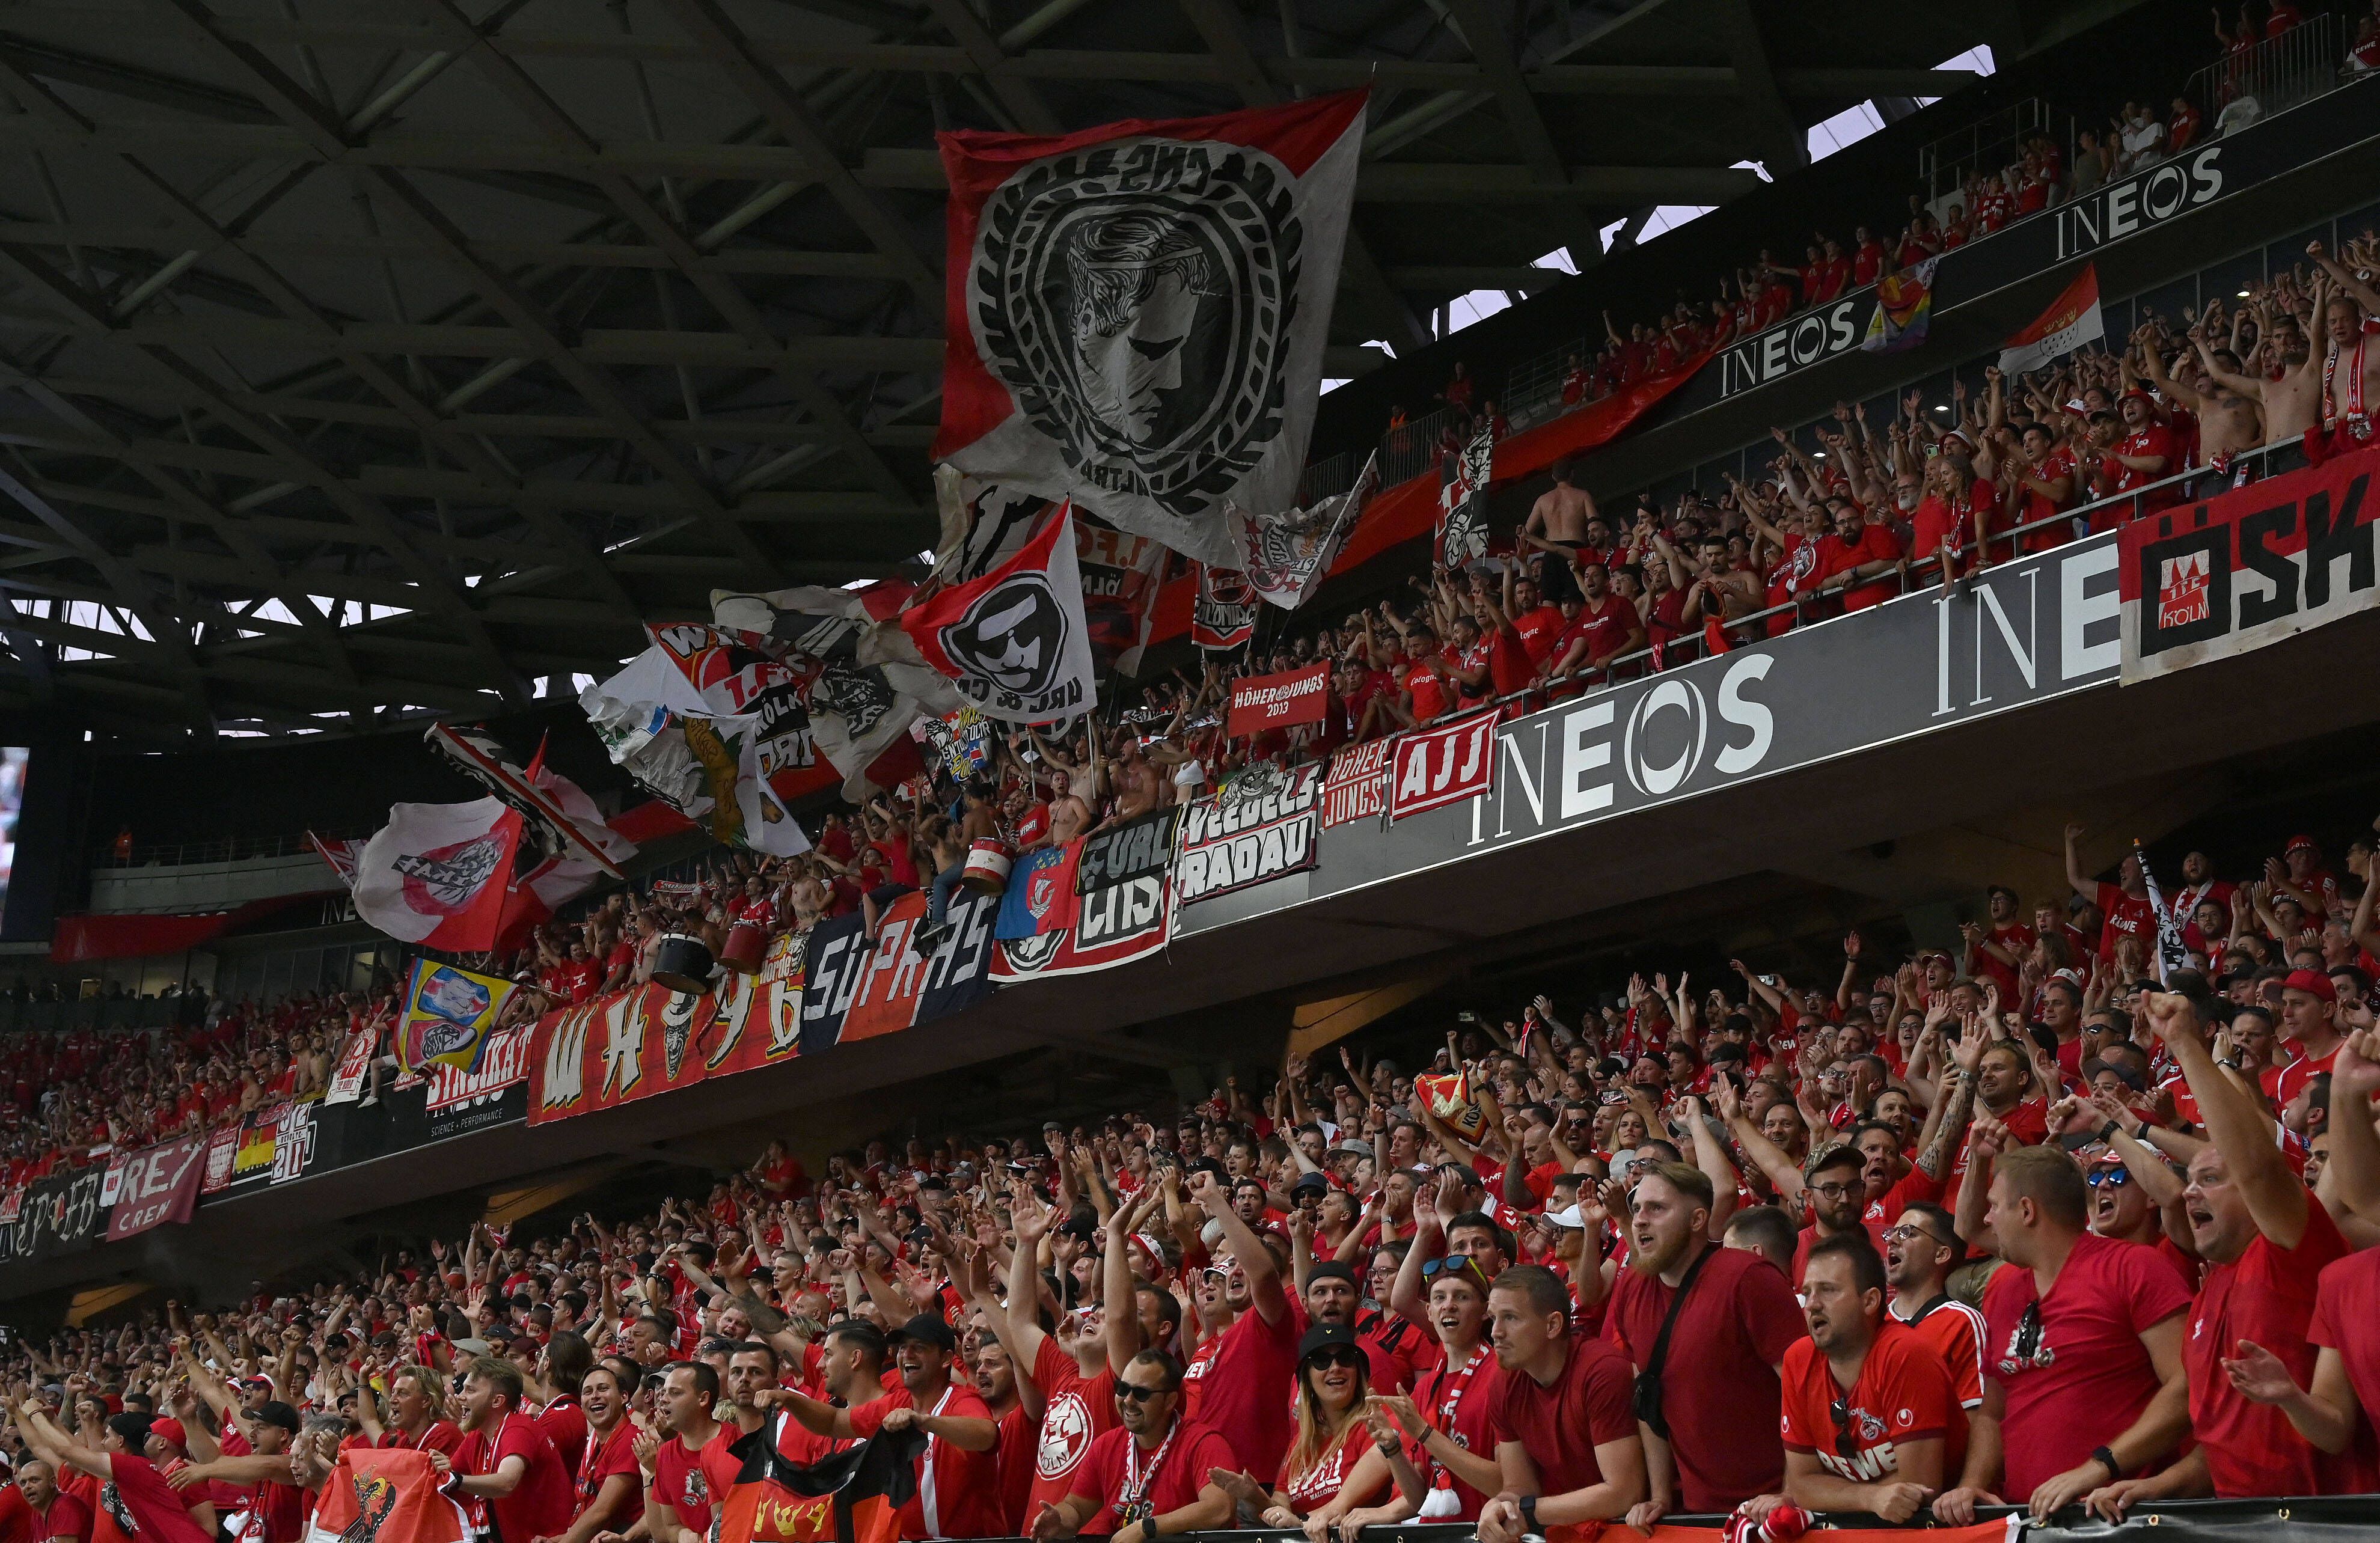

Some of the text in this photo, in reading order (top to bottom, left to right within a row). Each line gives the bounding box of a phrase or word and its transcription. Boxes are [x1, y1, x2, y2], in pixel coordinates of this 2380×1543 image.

[2355, 40, 2376, 54] REWE
[2055, 147, 2223, 261] INEOS
[1721, 302, 1855, 398] INEOS
[2162, 601, 2210, 629] KÖLN
[1234, 673, 1325, 709] HÖHER JUNGS
[1410, 674, 1437, 688] Cologn
[1265, 701, 1289, 718] 2013
[1329, 739, 1389, 785] HÖHER
[1400, 723, 1488, 802] AJJ
[1324, 777, 1383, 828] JUNGS
[1182, 817, 1312, 899] RADAU
[2109, 914, 2138, 933] REWE
[759, 954, 793, 985] Horde
[430, 1122, 452, 1138] SCIENCE
[460, 1108, 503, 1129] PERFORMANCE
[1816, 1443, 1898, 1482] REWE
[1303, 1488, 1315, 1497] PUB
[1310, 1485, 1342, 1502] MALLORCA
